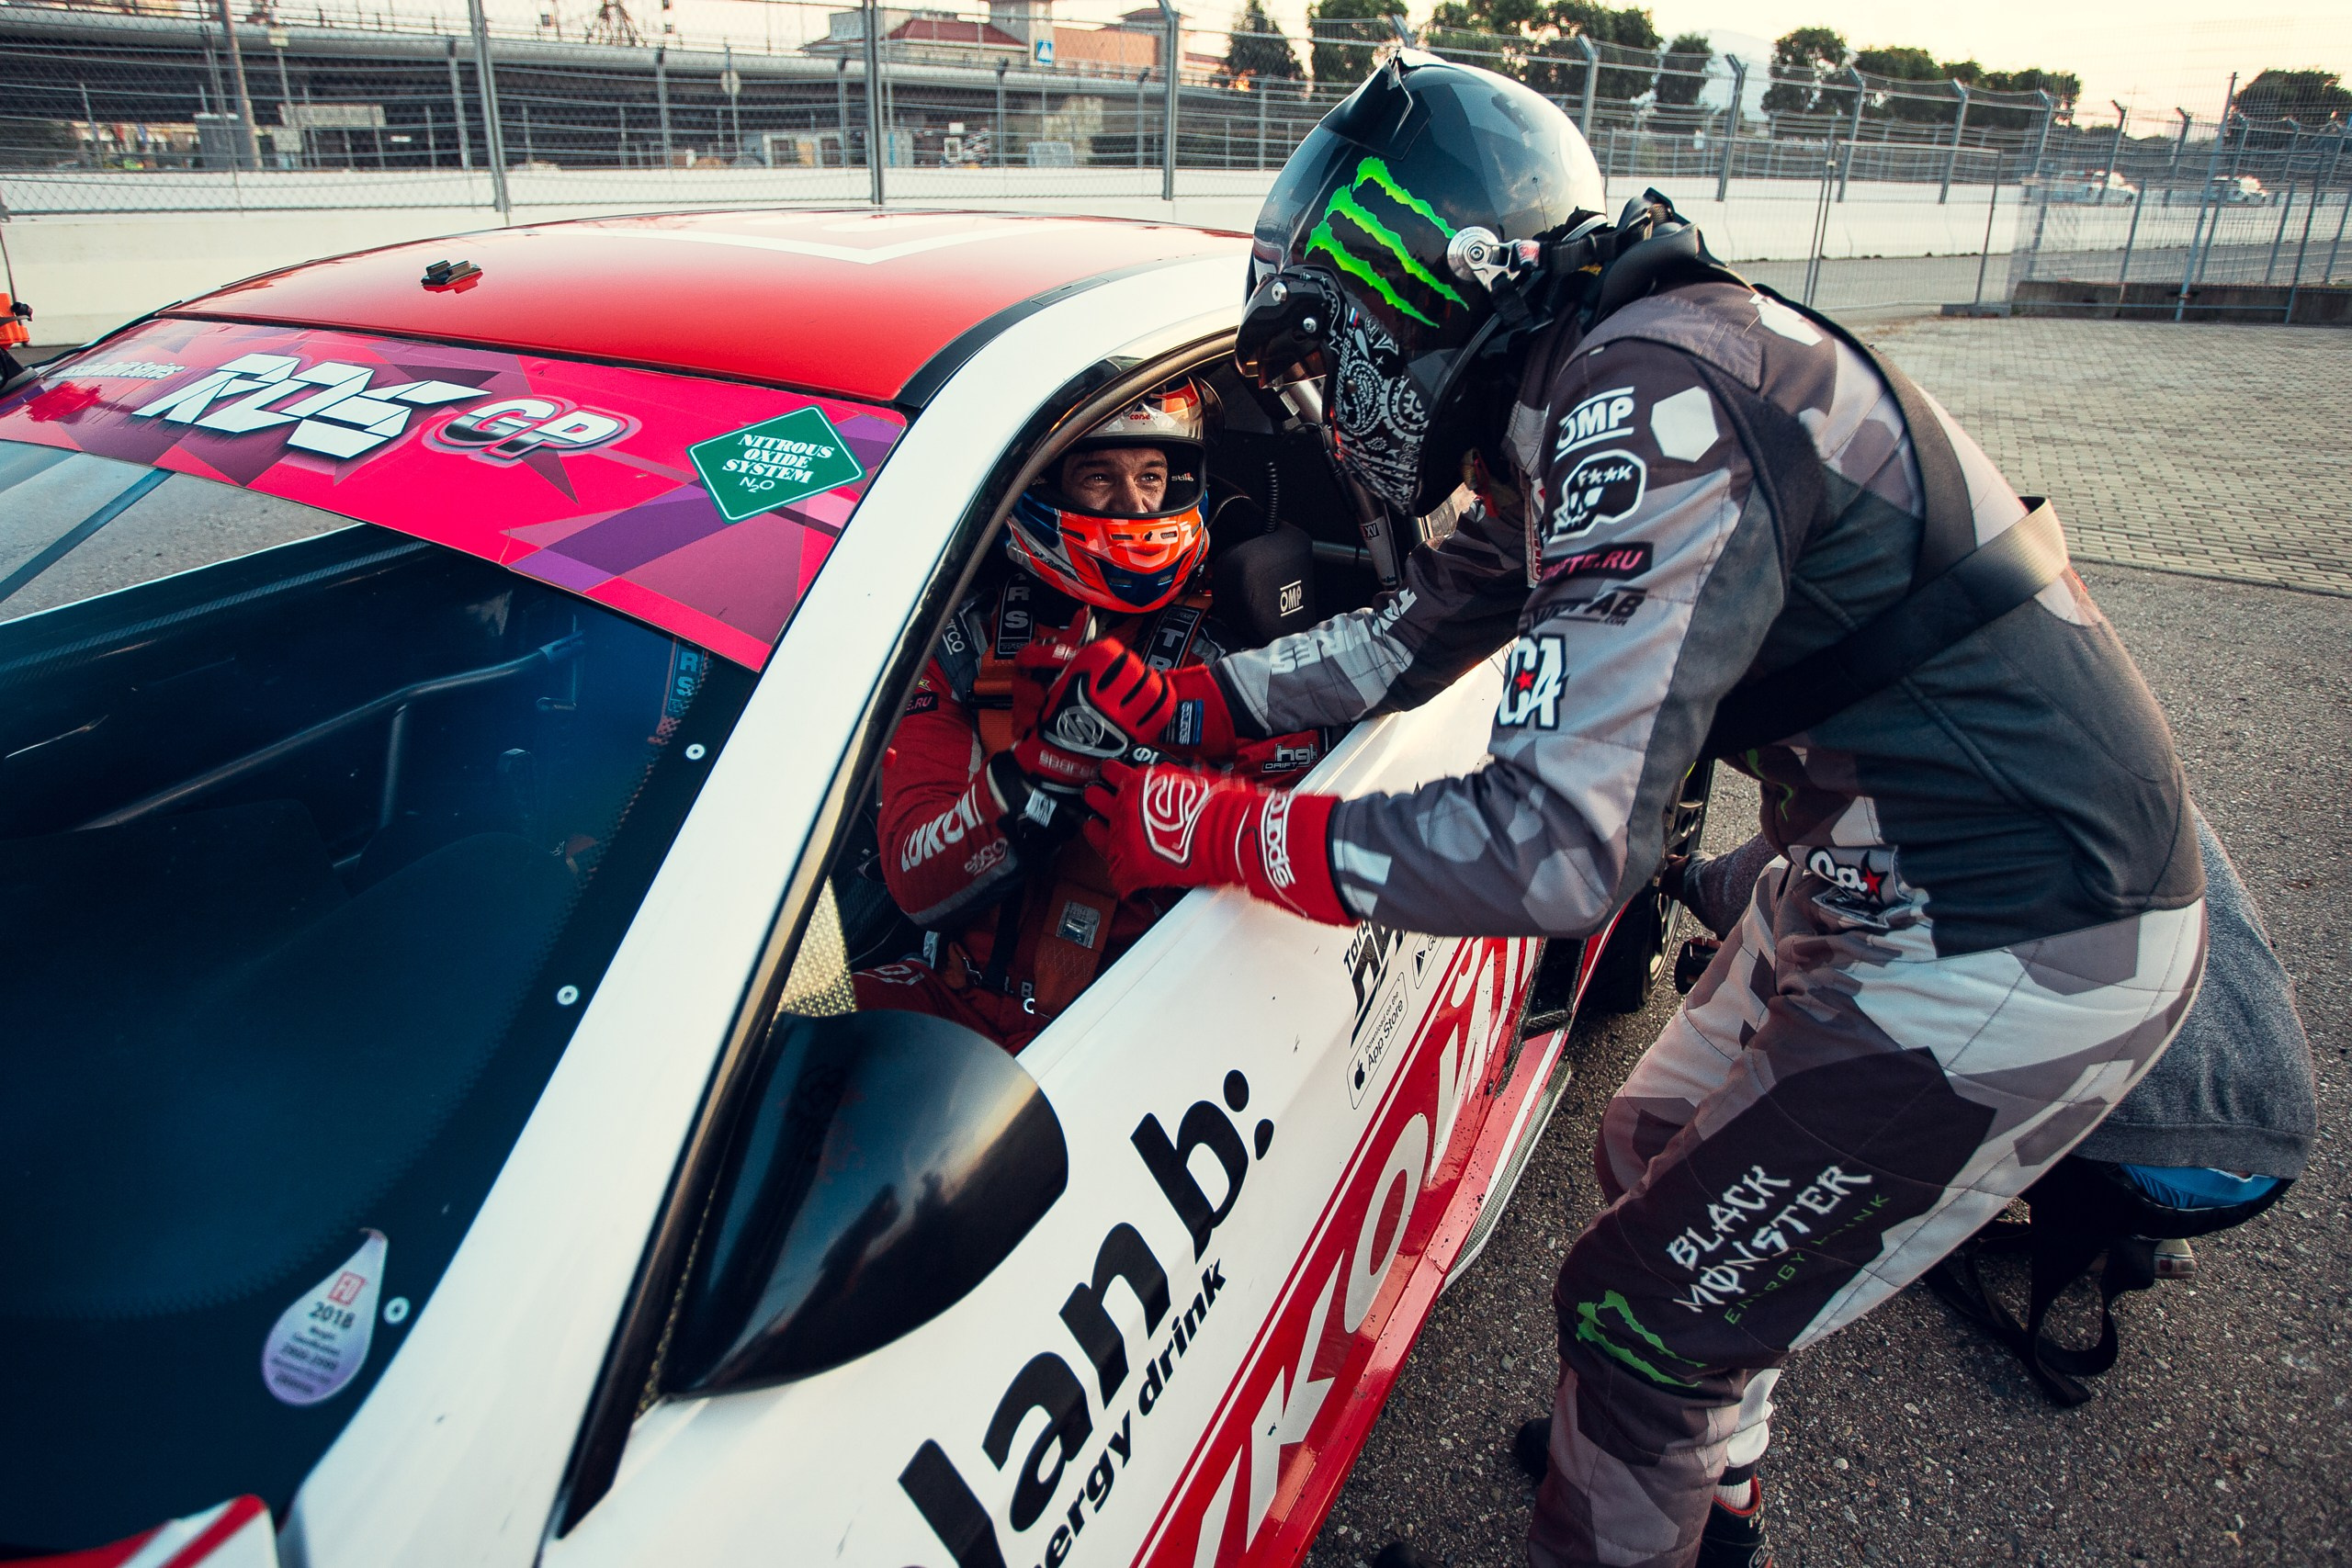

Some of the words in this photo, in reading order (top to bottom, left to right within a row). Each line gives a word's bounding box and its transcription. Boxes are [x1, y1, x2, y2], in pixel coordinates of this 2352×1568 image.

[132, 353, 493, 458] RDS
[443, 398, 623, 459] GP
[1558, 395, 1634, 448] OMP
[738, 434, 834, 458] NITROUS
[743, 448, 812, 468] OXIDE
[722, 458, 814, 483] SYSTEM
[1280, 587, 1303, 611] OMP
[1264, 761, 1297, 773] DRIFT
[1364, 1014, 1387, 1055] Download
[1367, 1035, 1385, 1072] App
[1383, 998, 1405, 1038] Store
[1666, 1165, 1791, 1271] BLACK
[1672, 1165, 1872, 1314] MONSTER
[309, 1301, 356, 1330] 2018
[898, 1223, 1171, 1568] lan
[1035, 1409, 1132, 1568] ergy
[1138, 1258, 1227, 1416] drink
